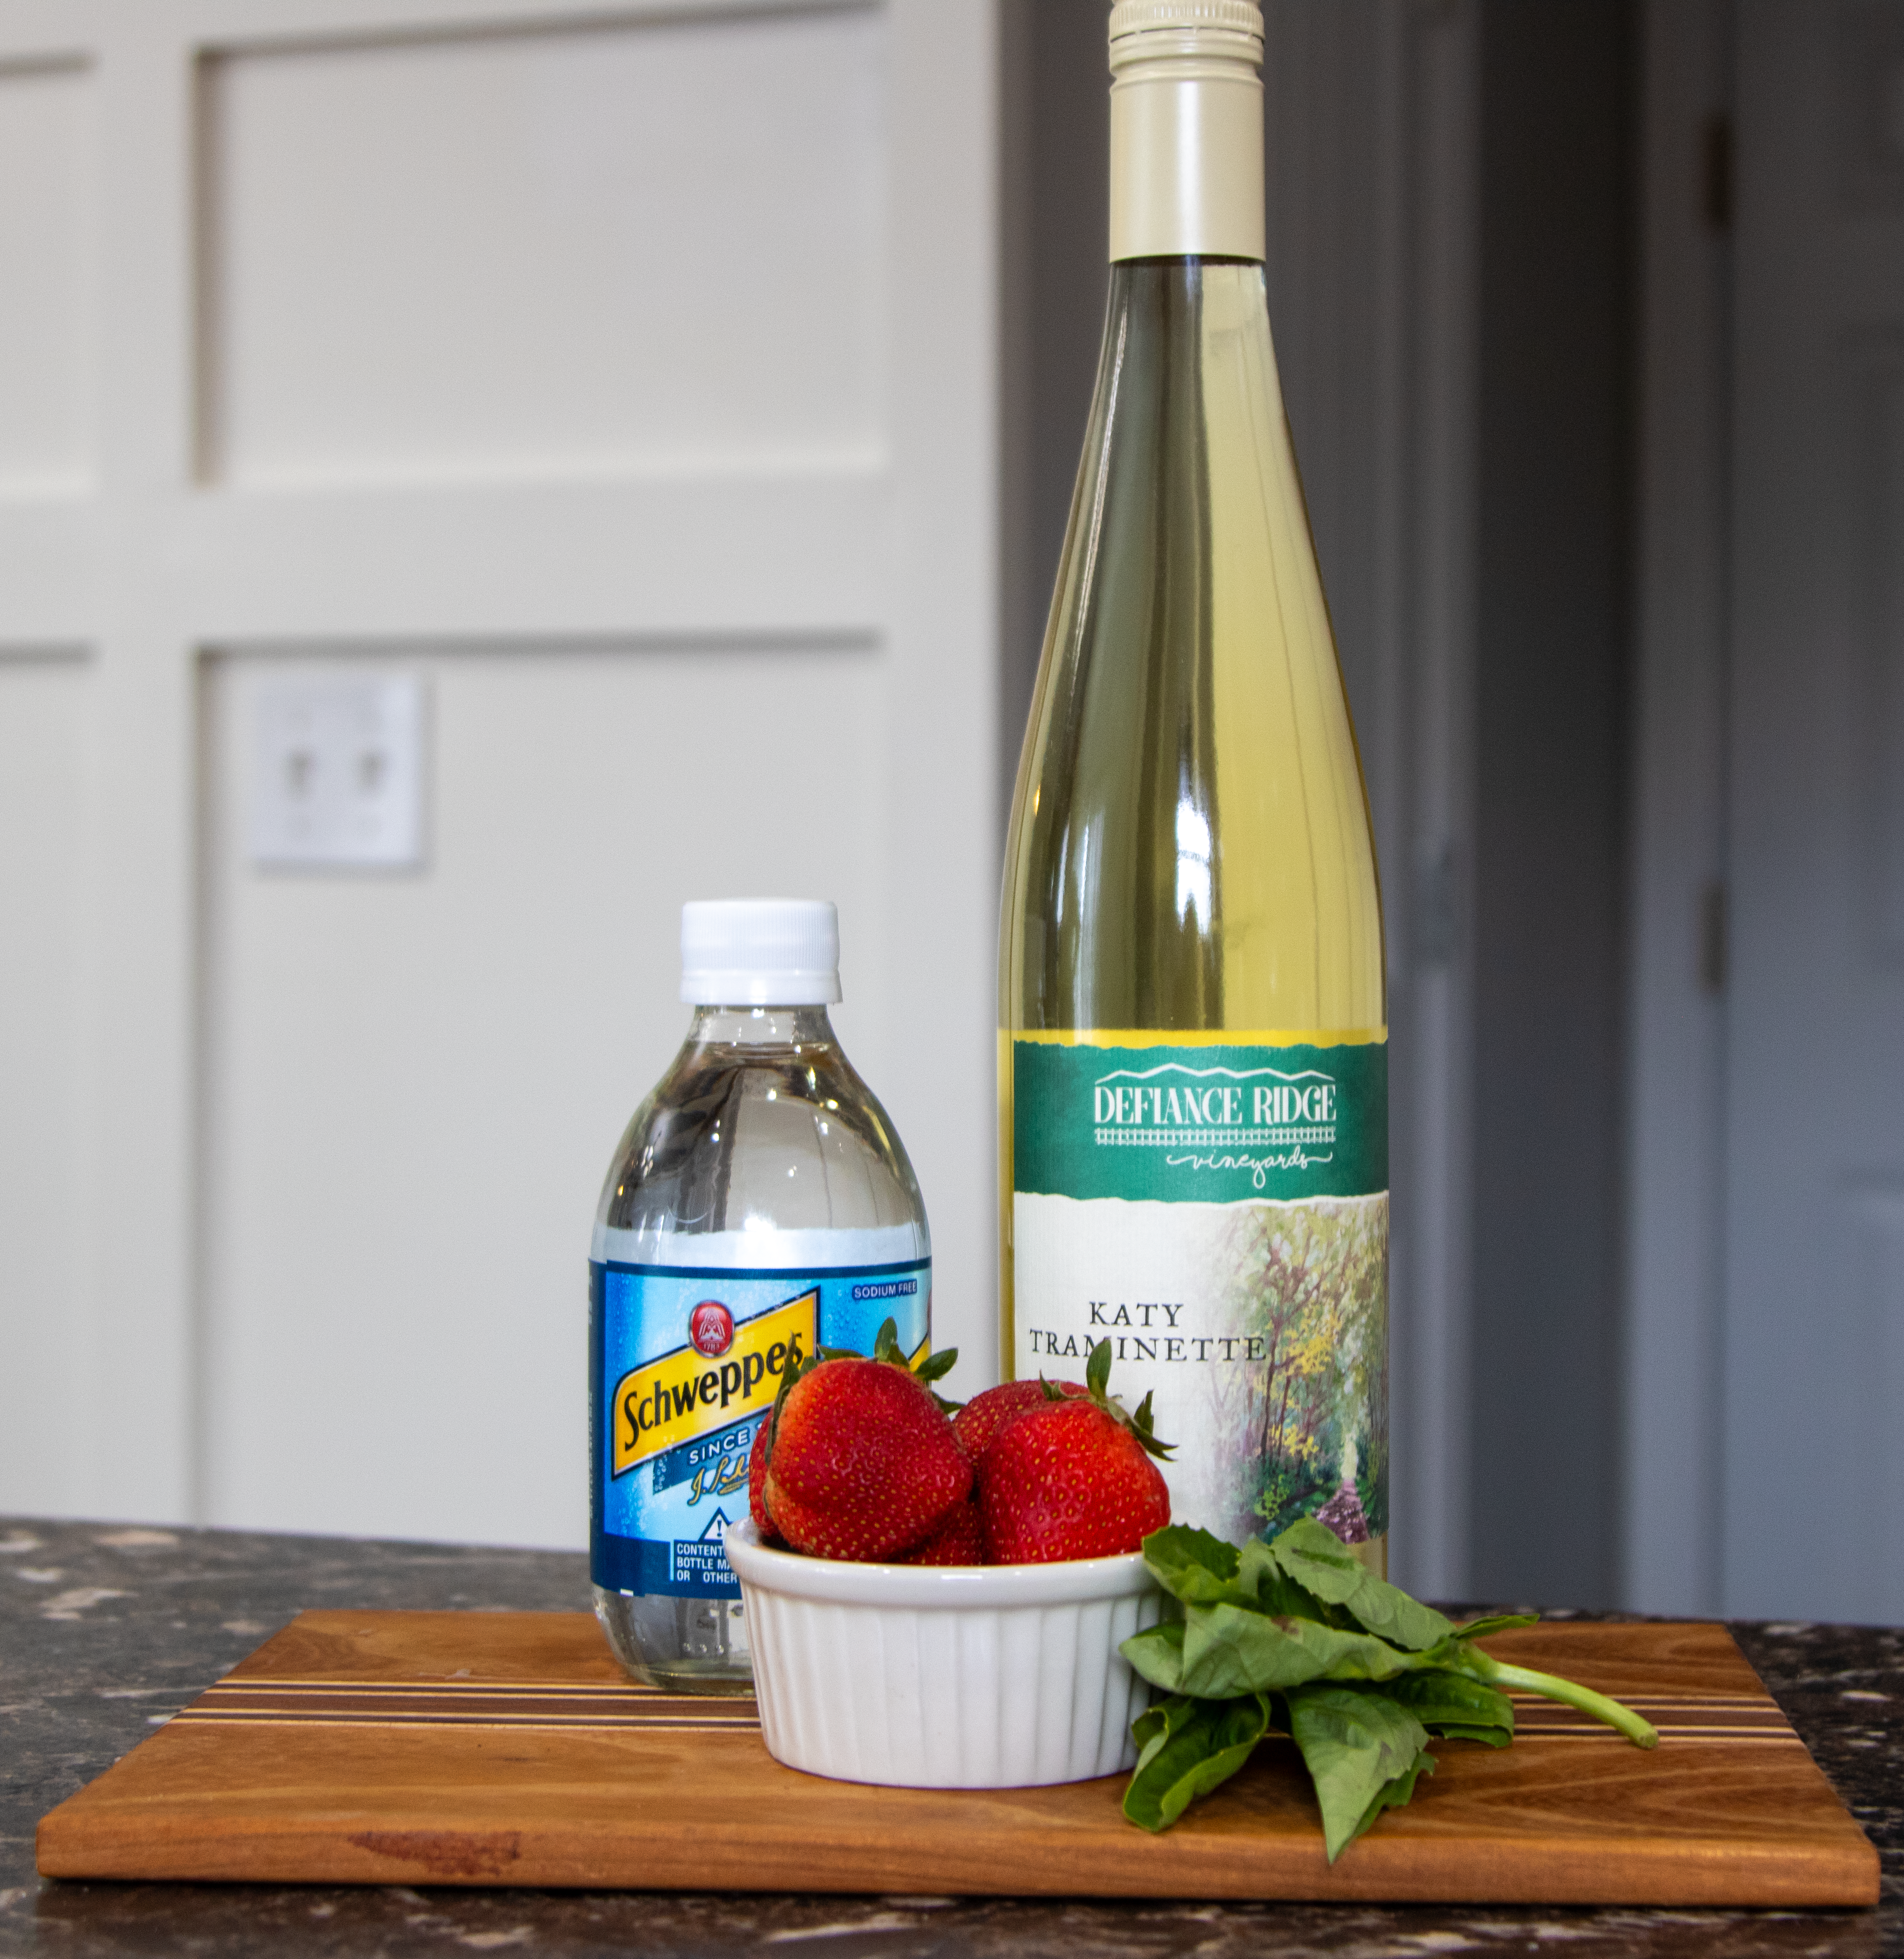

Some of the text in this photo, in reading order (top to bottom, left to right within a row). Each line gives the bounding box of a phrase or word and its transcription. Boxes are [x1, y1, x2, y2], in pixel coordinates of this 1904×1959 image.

[1095, 1084, 1337, 1125] DEFIANCE RIDGE
[1166, 1144, 1333, 1189] vineyards
[854, 1280, 917, 1298] SODIUM FREE
[1089, 1301, 1184, 1327] KATY
[624, 1332, 803, 1452] Schweppes
[689, 1428, 748, 1464] SINCE
[677, 1543, 724, 1557] CONTENT
[677, 1556, 714, 1570] BOTTLE
[677, 1569, 738, 1584] OR OTHER
